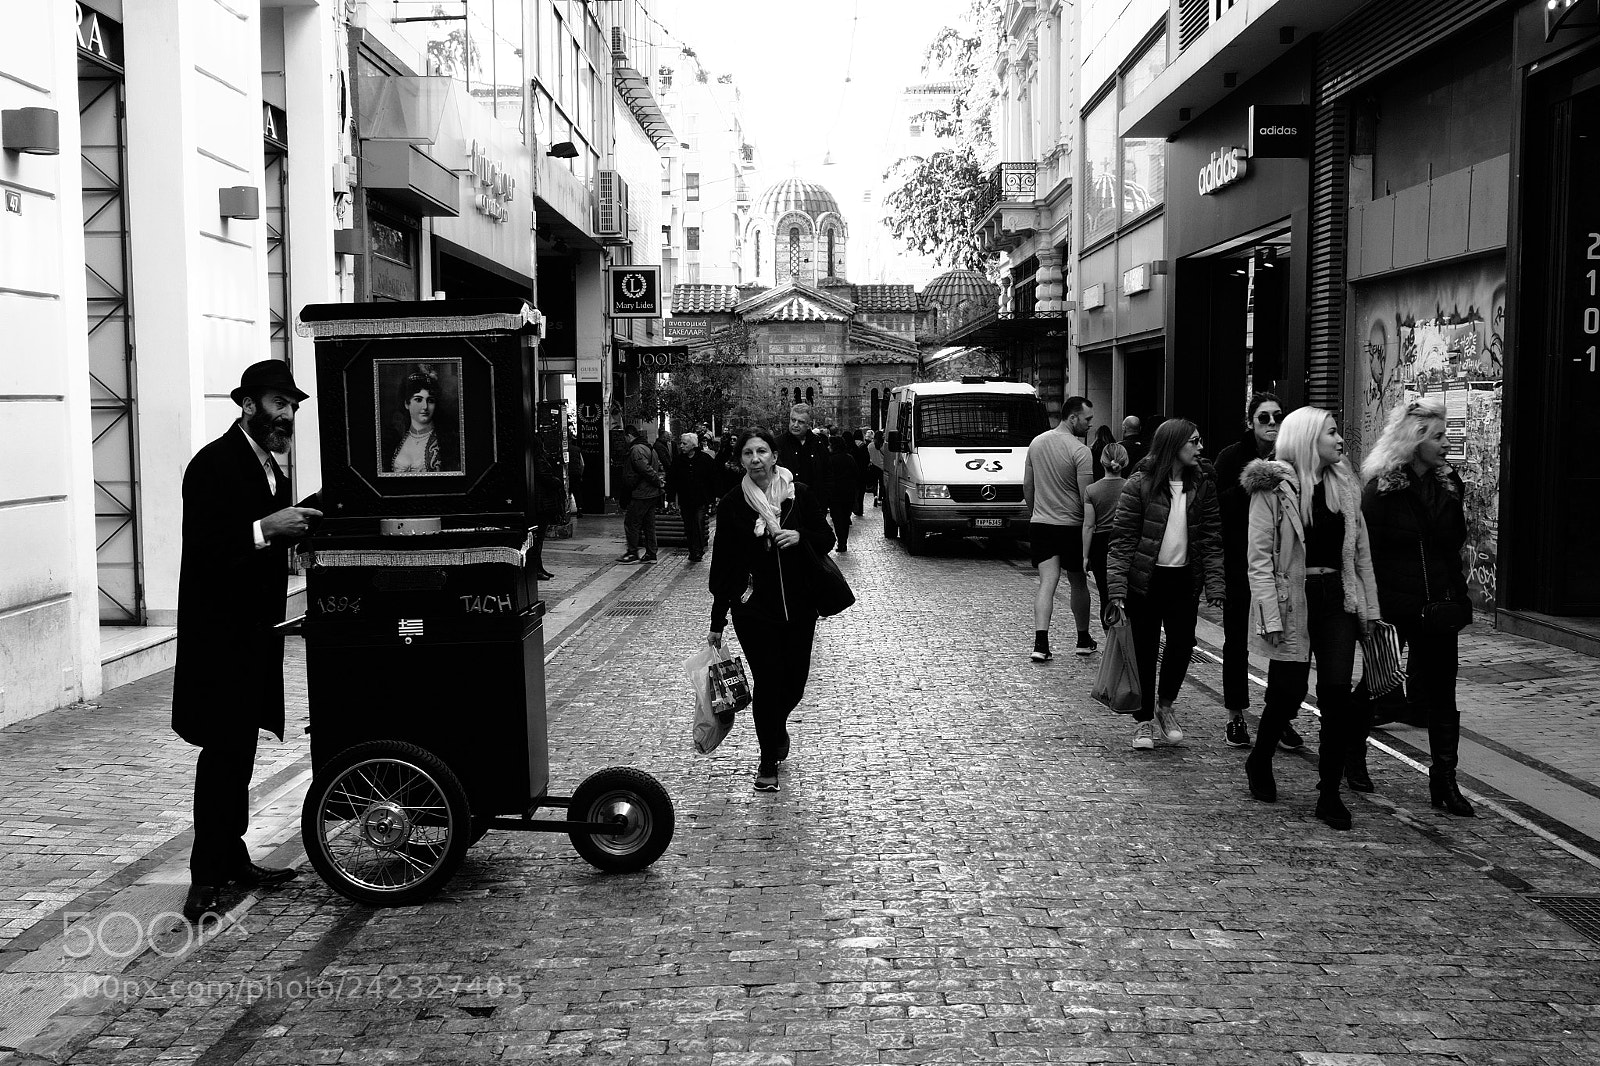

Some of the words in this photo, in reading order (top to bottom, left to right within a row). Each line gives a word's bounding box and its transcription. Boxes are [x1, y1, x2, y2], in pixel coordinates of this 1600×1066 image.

[1259, 126, 1298, 135] adidas
[1199, 147, 1243, 196] adidas
[1586, 269, 1596, 296] 1
[616, 301, 635, 310] Mary
[635, 301, 654, 309] Lides
[668, 319, 707, 328] ανατομικά
[637, 353, 685, 369] JOOLS
